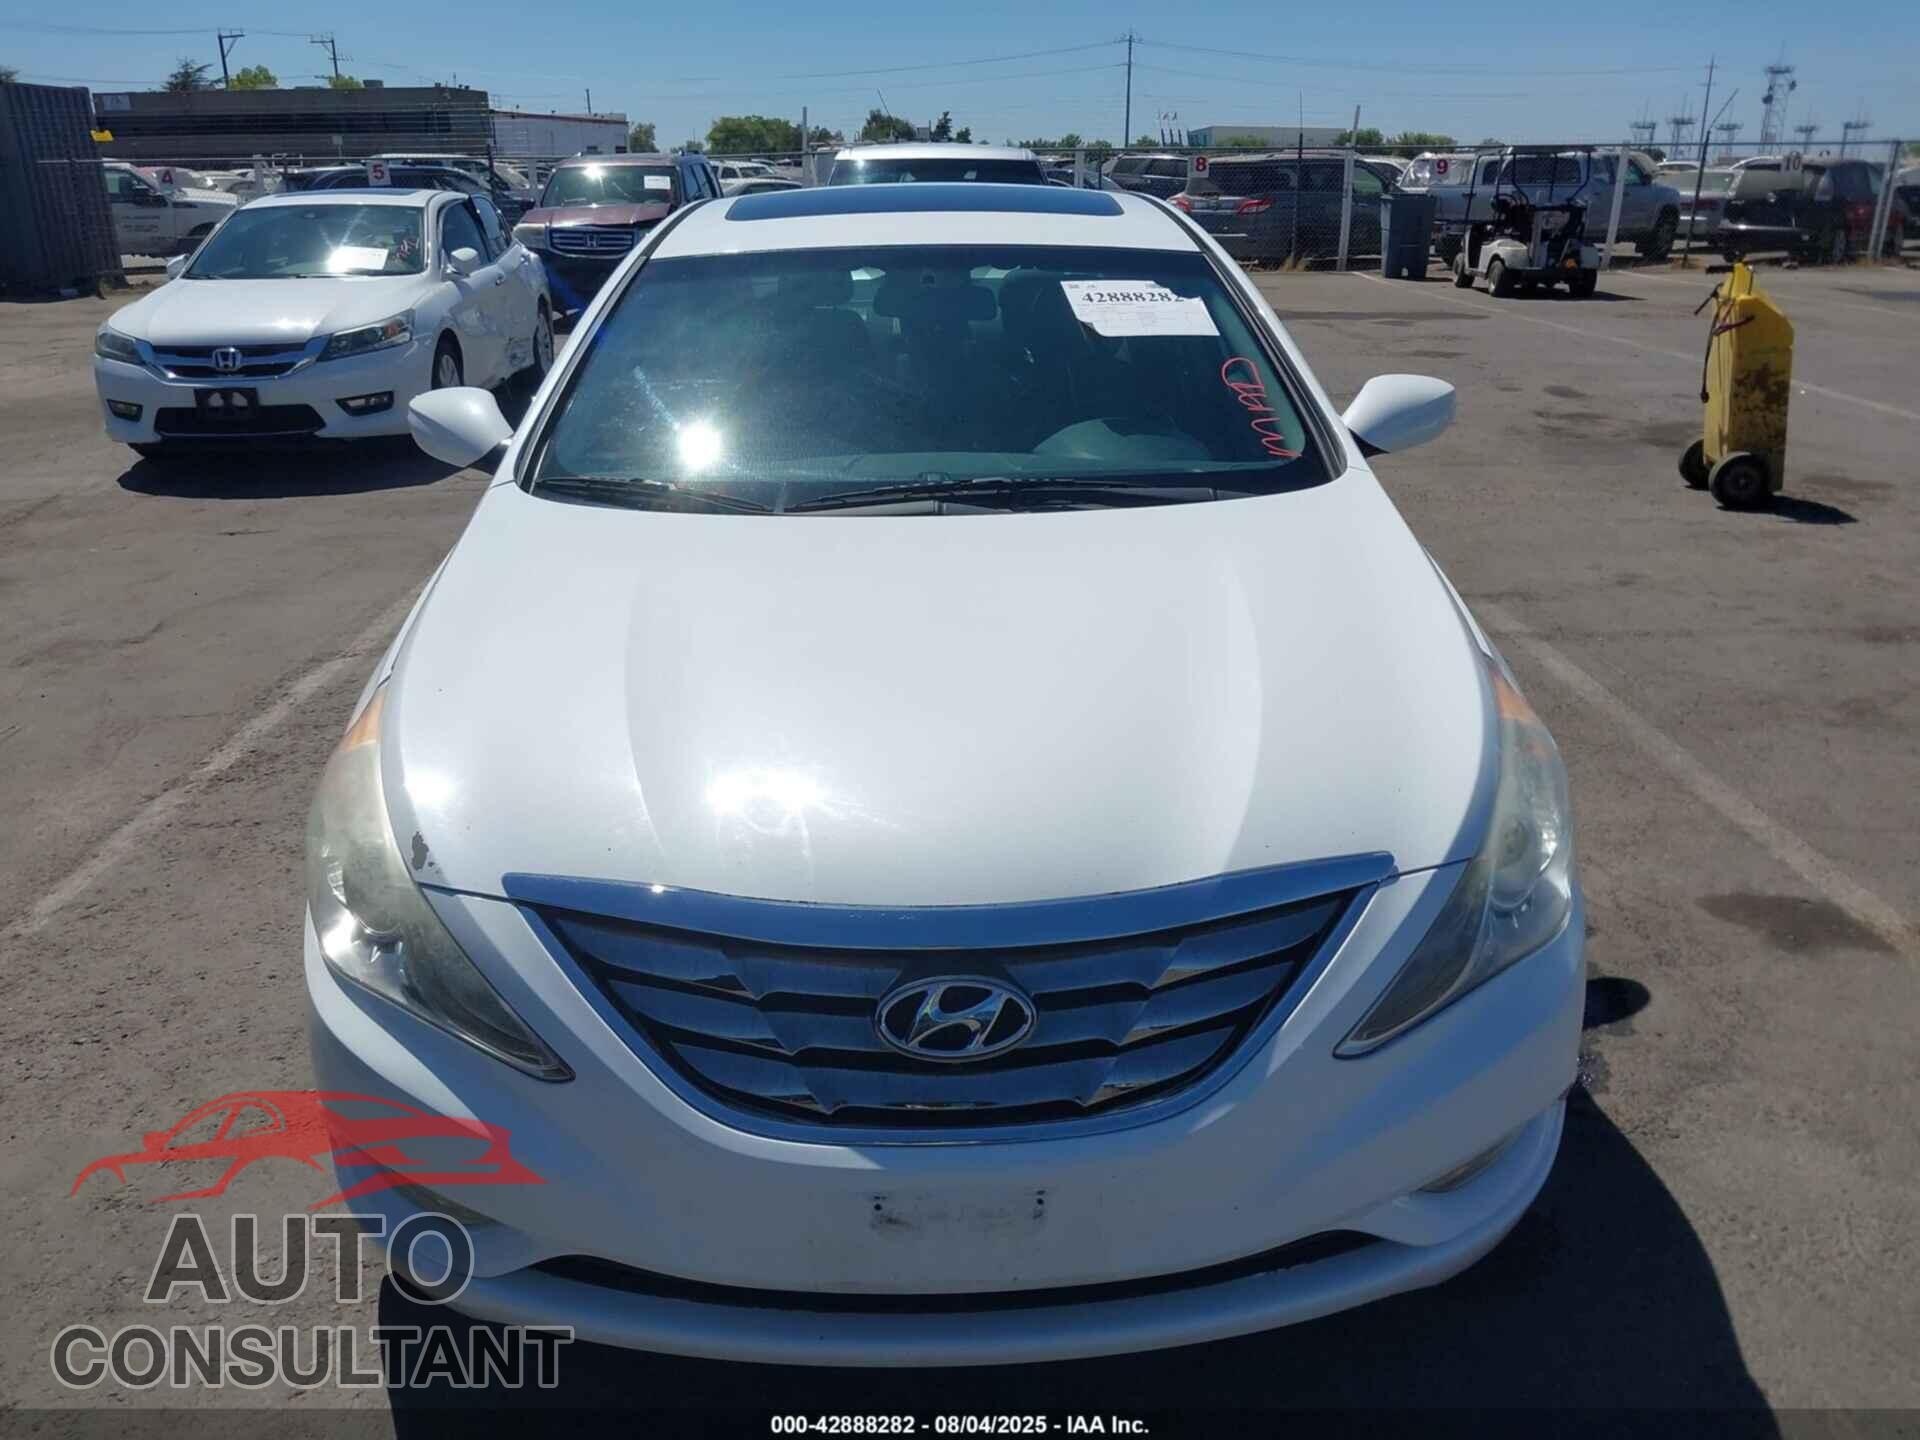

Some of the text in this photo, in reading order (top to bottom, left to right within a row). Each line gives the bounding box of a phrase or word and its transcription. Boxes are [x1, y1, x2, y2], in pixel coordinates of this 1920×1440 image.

[372, 164, 385, 180] 5
[1195, 156, 1207, 172] 8
[1436, 159, 1448, 175] 9
